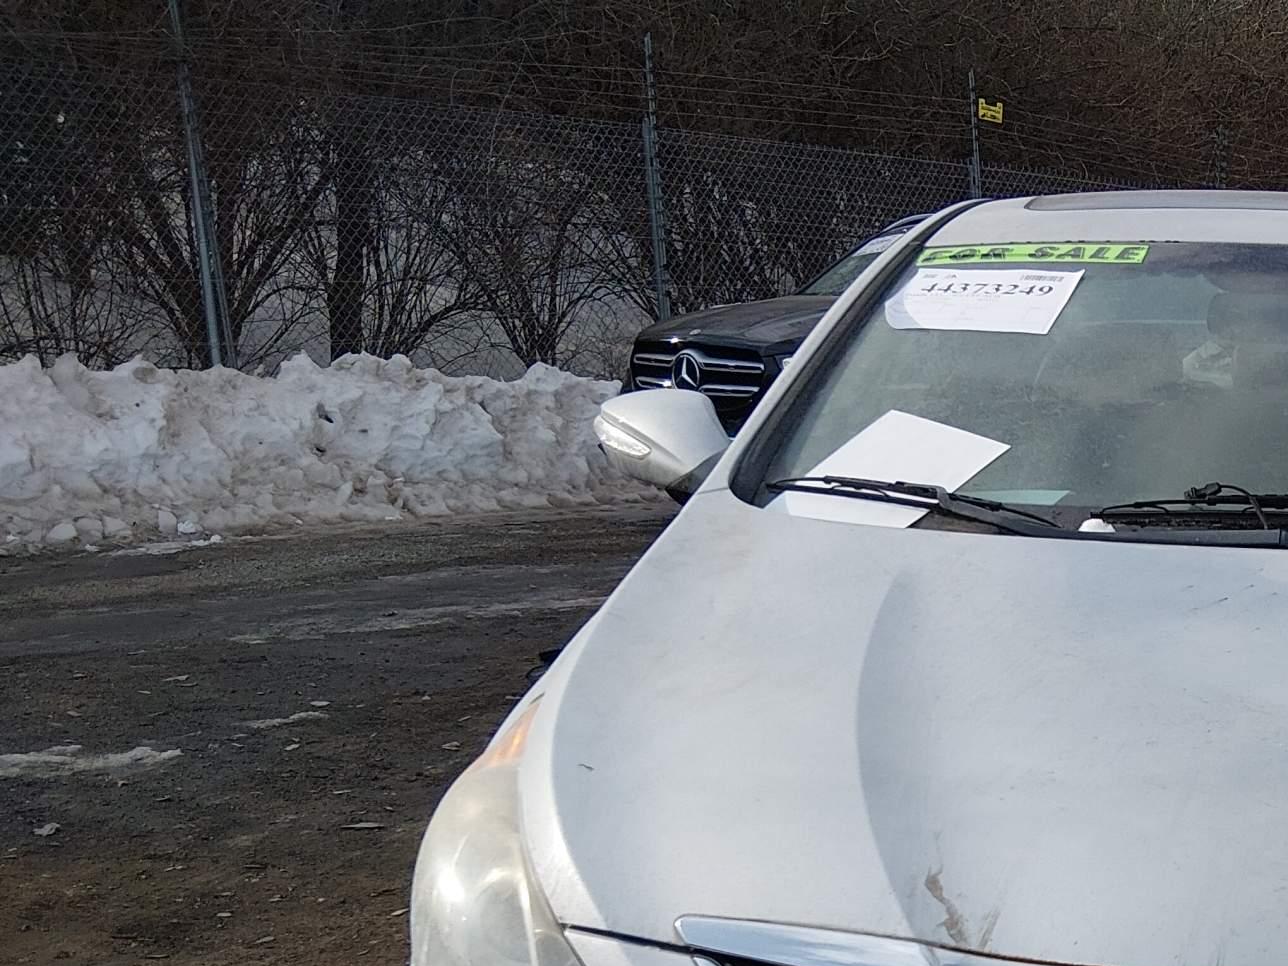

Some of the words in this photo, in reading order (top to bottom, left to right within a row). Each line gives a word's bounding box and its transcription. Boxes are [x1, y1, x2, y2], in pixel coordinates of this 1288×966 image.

[921, 246, 1014, 263] FOR
[1028, 246, 1144, 261] SALE
[921, 282, 1054, 297] 44373249
